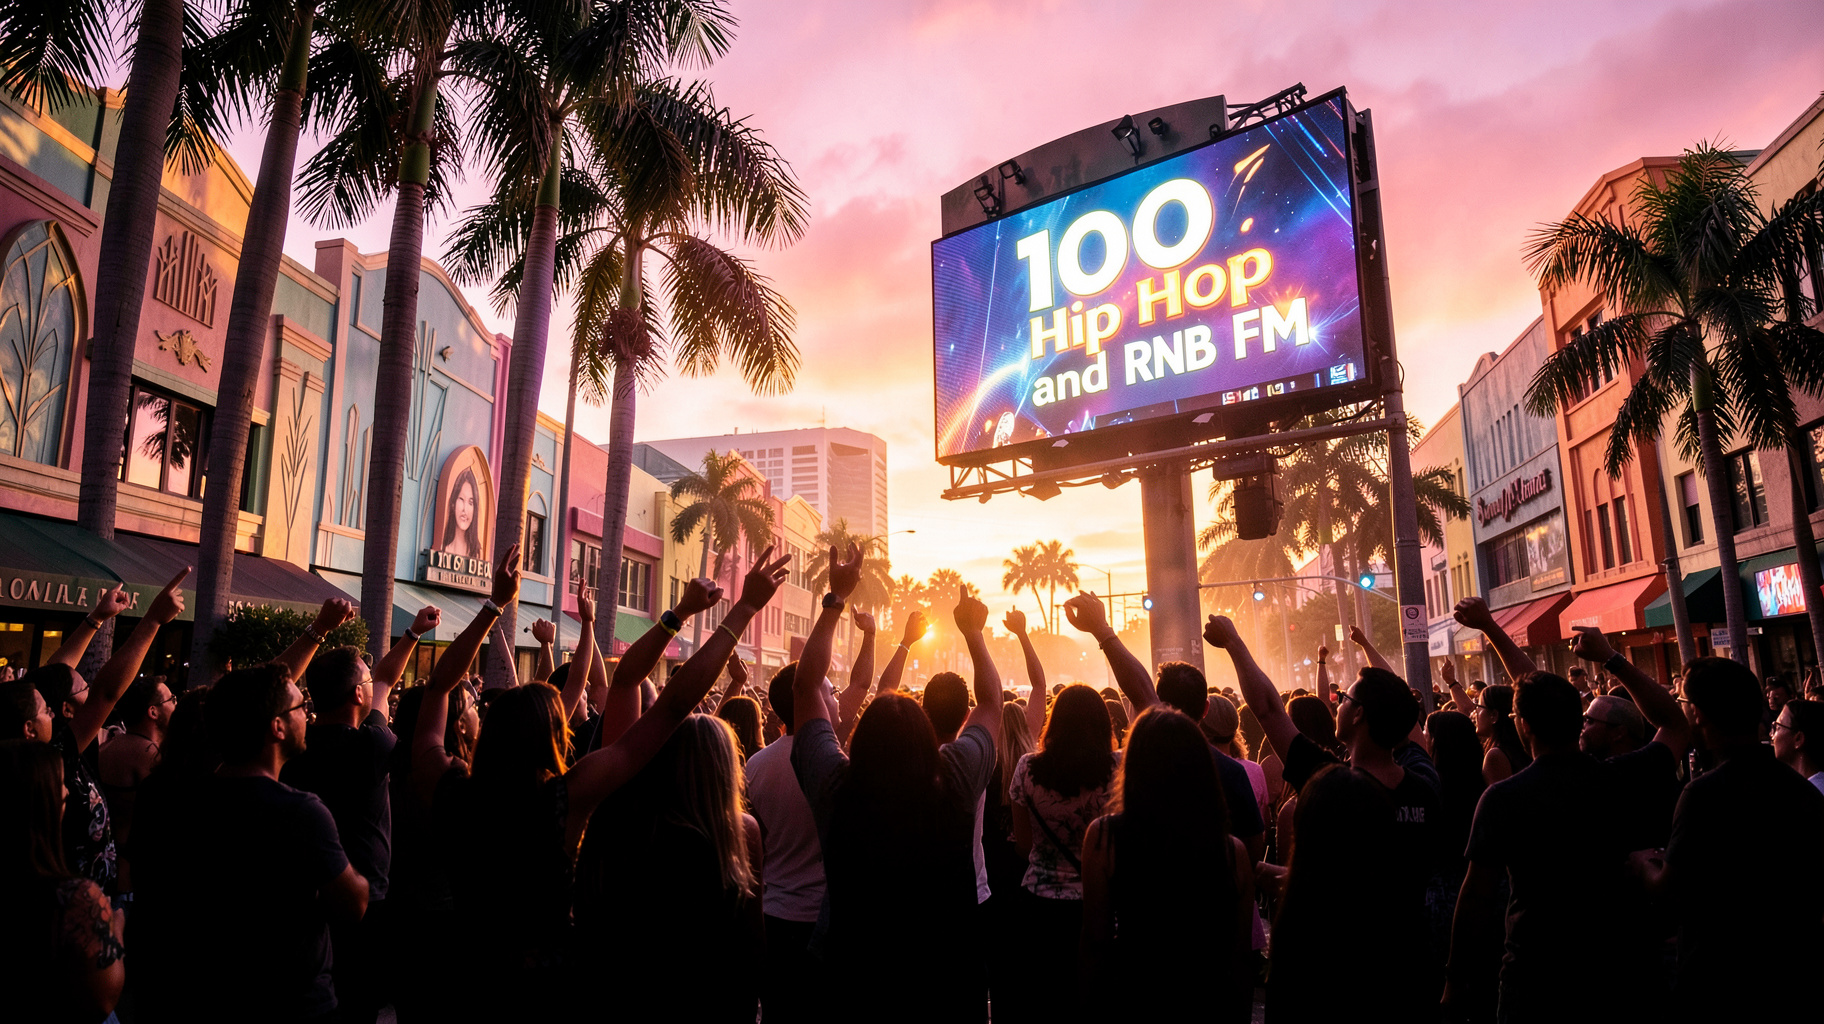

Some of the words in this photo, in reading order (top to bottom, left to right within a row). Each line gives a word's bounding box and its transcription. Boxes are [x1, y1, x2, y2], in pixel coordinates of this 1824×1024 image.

[1016, 178, 1214, 312] 100
[1029, 300, 1122, 360] Hip
[1135, 247, 1273, 326] Hop
[1031, 351, 1109, 408] and
[1123, 324, 1217, 386] RNB
[1232, 296, 1311, 360] FM
